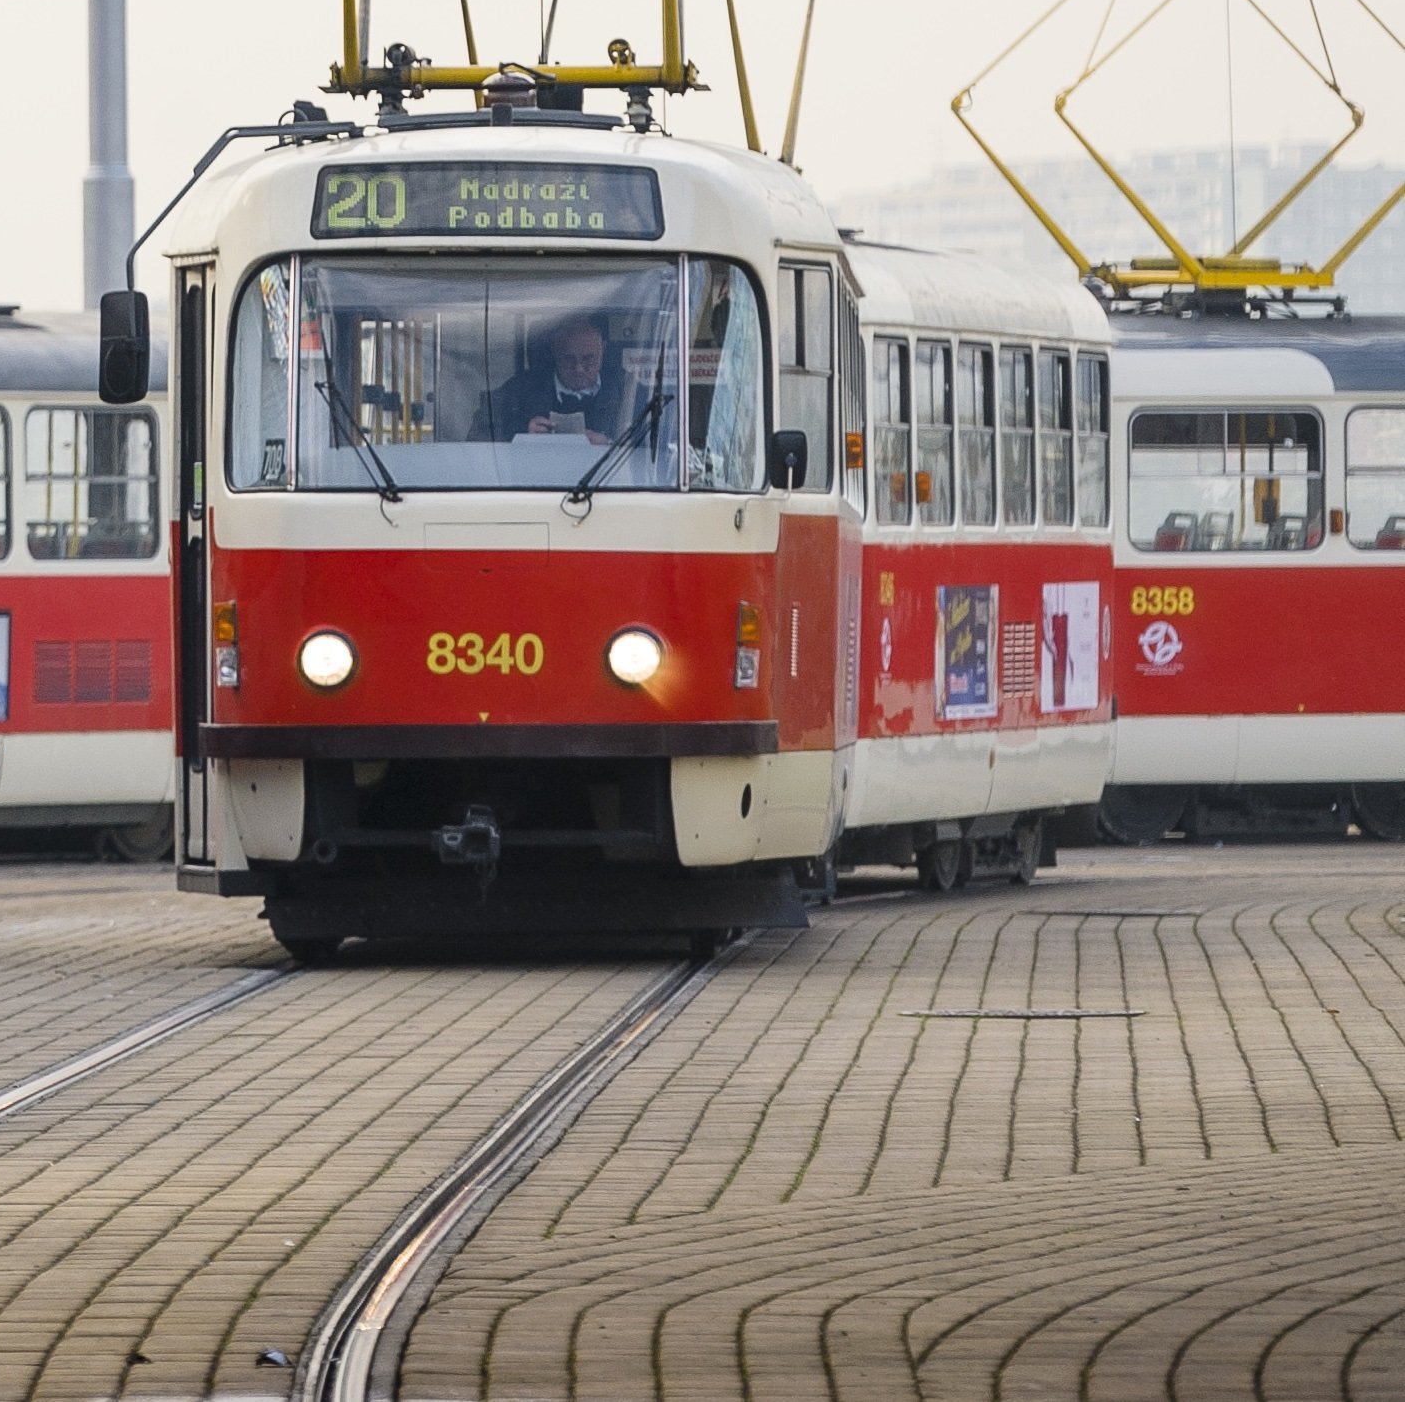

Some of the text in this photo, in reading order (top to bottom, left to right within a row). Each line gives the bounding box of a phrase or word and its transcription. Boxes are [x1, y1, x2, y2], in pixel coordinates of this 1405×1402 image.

[327, 172, 407, 230] 20
[459, 176, 591, 200] Nádraží
[448, 205, 606, 230] Podbaba
[1131, 585, 1196, 616] 8358
[426, 632, 544, 675] 8340
